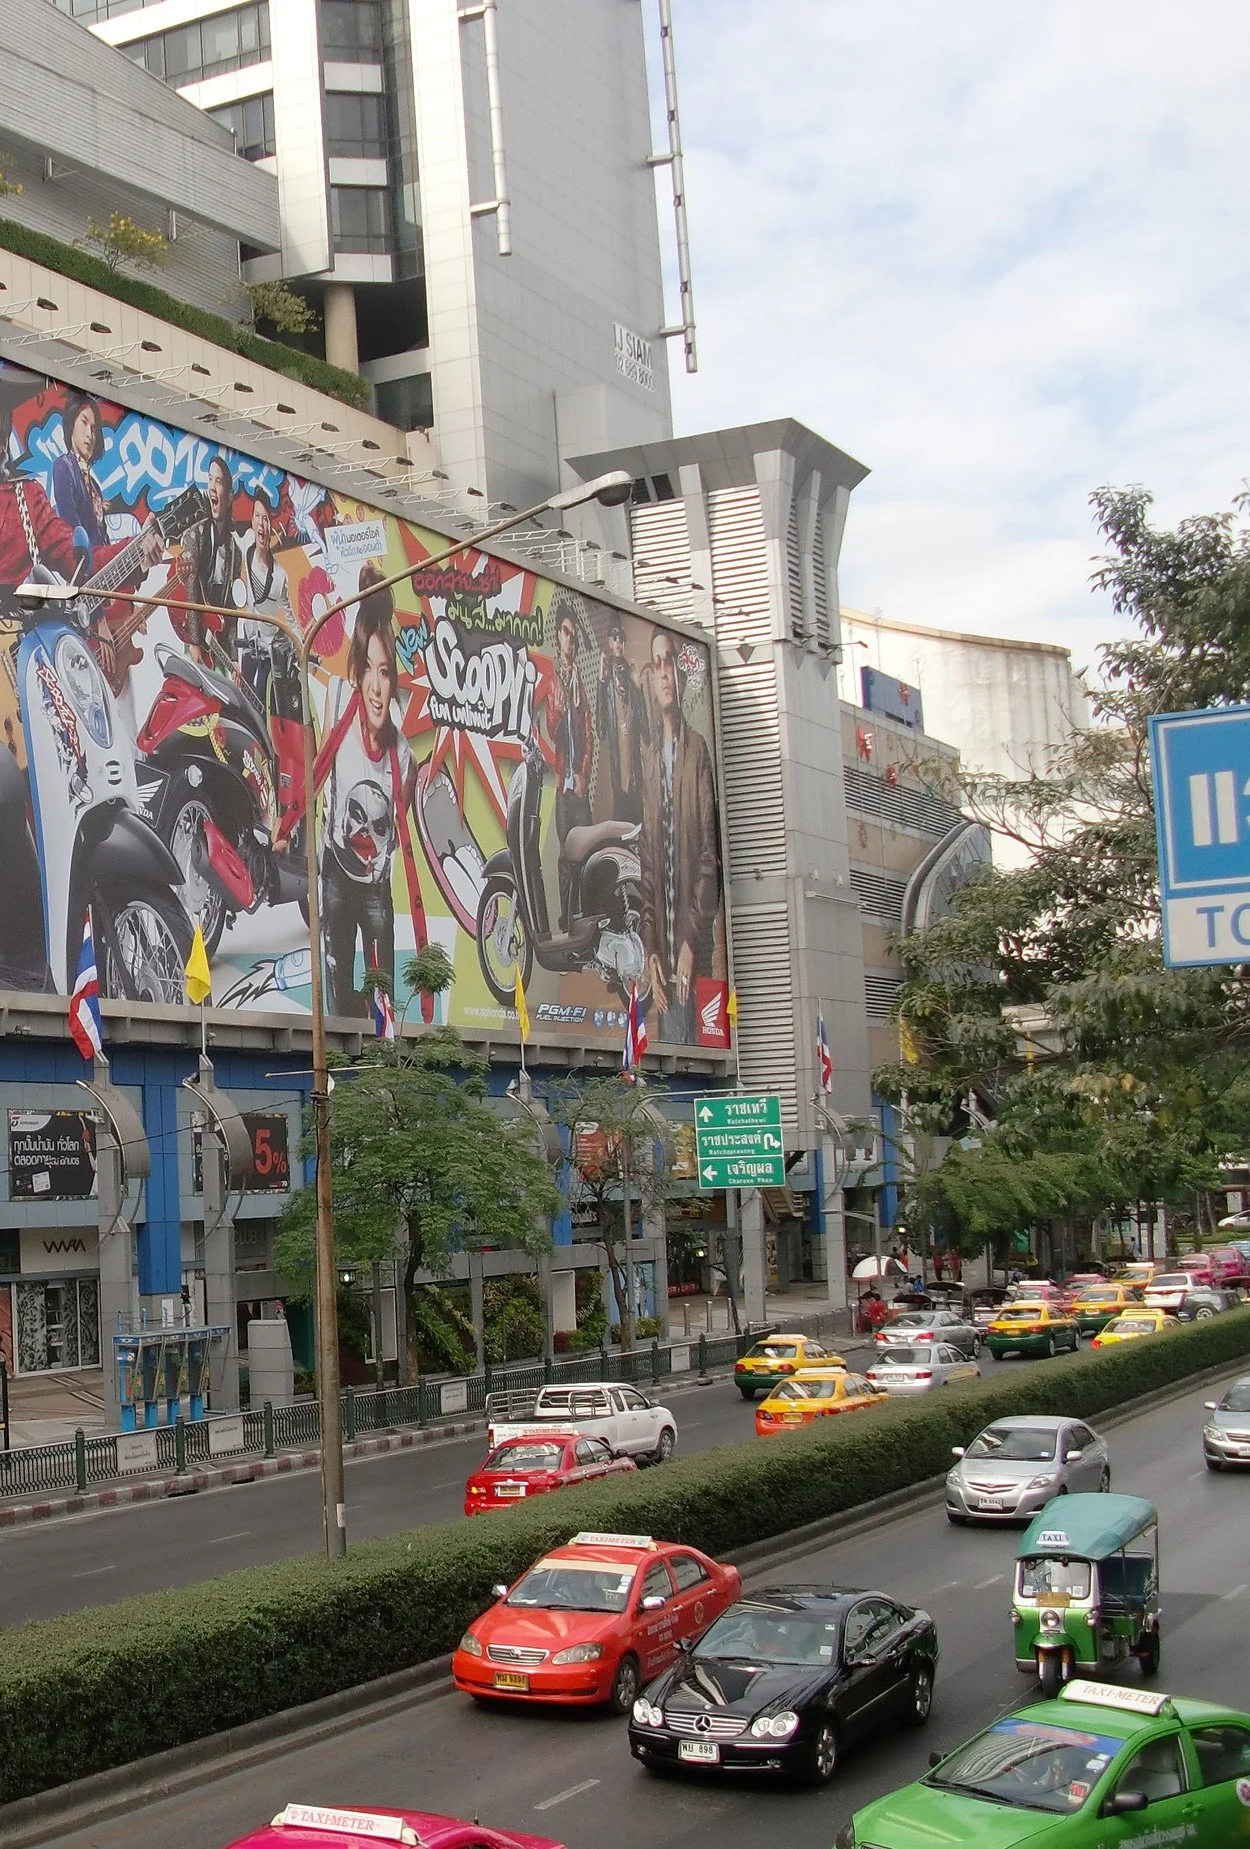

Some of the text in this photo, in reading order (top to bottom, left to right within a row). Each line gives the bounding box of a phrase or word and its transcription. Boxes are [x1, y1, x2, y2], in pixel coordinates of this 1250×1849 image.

[702, 1025, 725, 1036] HONDA
[725, 1098, 768, 1116] ราชเทวี
[701, 1130, 764, 1147] ราชประสงค์
[727, 1159, 774, 1176] เจริญผล
[589, 1535, 637, 1545] TAXI-METER
[1041, 1533, 1063, 1542] TAXI
[1082, 1685, 1160, 1706] TAXI-METER
[698, 1744, 713, 1754] 898
[298, 1808, 376, 1832] TAXI-METER
